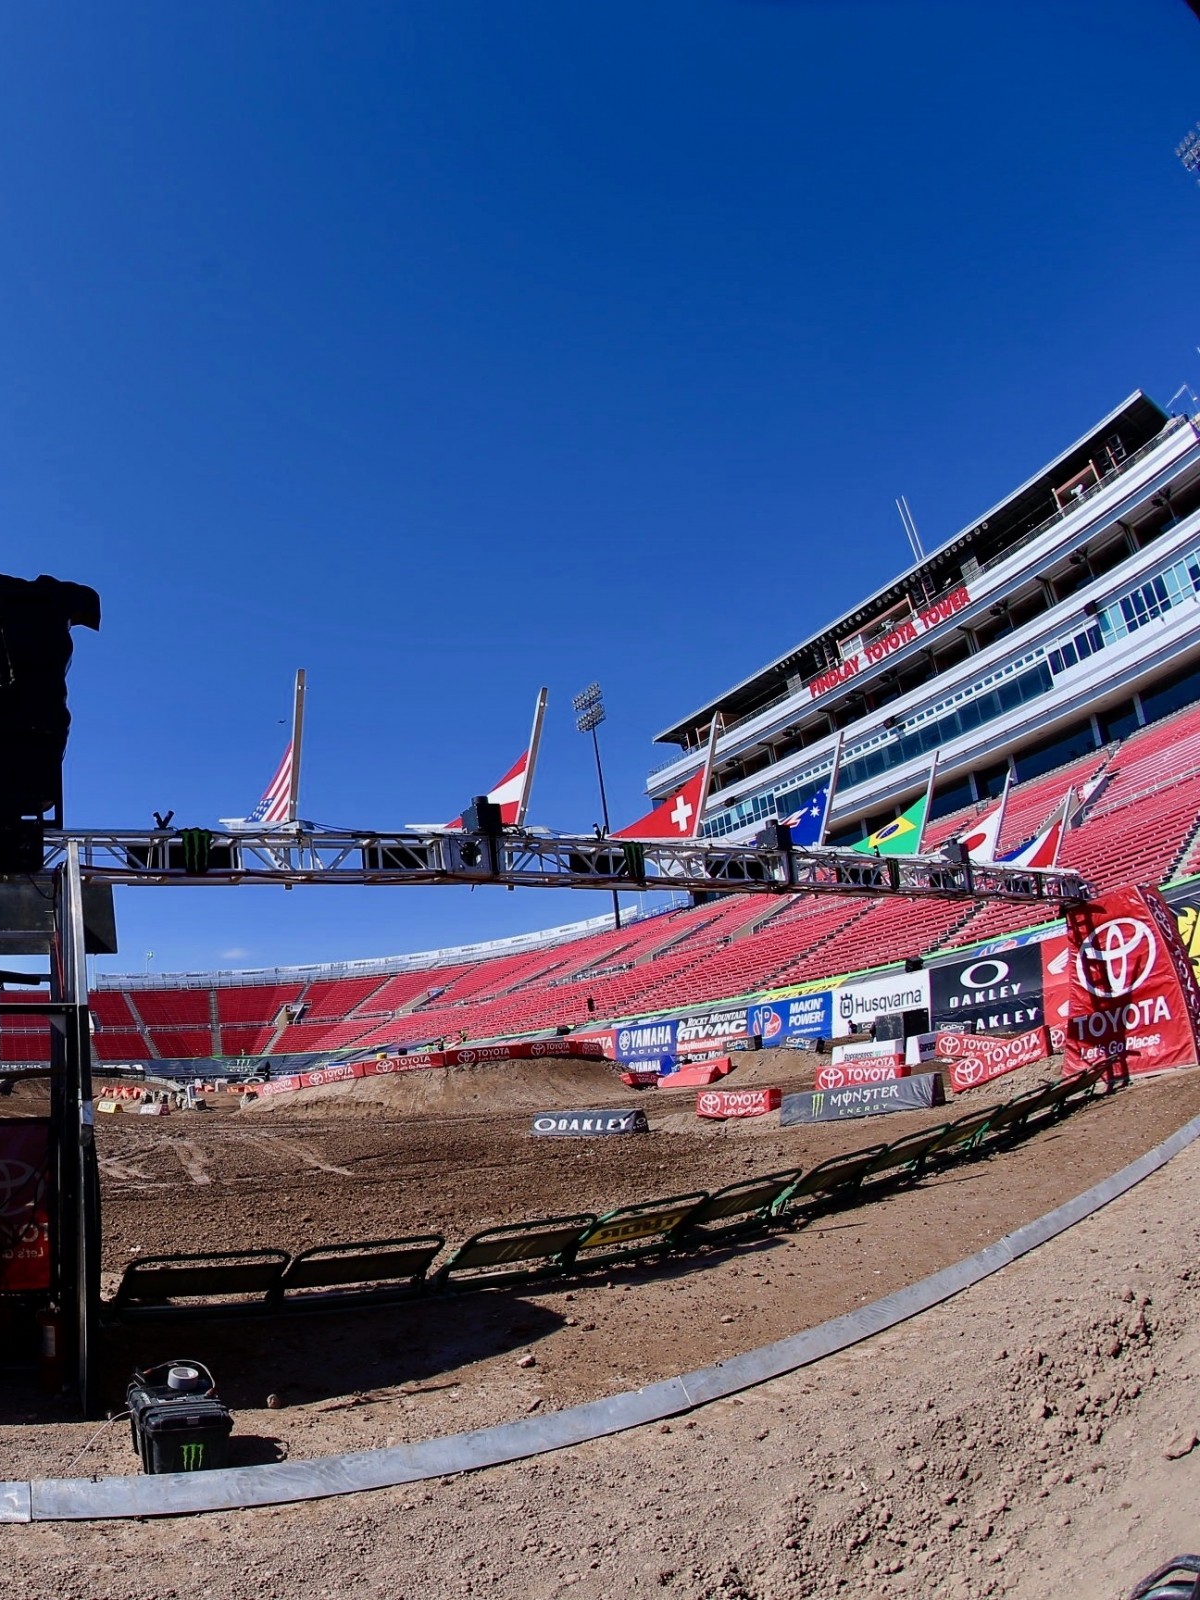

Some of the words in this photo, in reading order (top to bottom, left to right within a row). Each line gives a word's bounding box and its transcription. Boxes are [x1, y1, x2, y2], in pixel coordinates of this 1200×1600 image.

[809, 656, 860, 698] FINDLAY
[864, 621, 918, 664] TOYOTA
[918, 586, 970, 629] TOWER
[855, 989, 922, 1014] Husqvarna
[949, 983, 1021, 1008] OAKLEY
[687, 1016, 708, 1027] ROCKY
[709, 1010, 747, 1023] MOUNTAIN
[789, 1010, 826, 1027] POWER!
[963, 1007, 1039, 1030] AKLEY
[1073, 996, 1171, 1040] TOYOTA
[631, 1025, 671, 1048] YAMAHA
[726, 1040, 748, 1048] GoPro
[786, 1037, 810, 1045] GoPro
[477, 1048, 510, 1056] TOYOTA
[623, 1046, 669, 1056] RACING
[962, 1039, 1001, 1050] TOYOT
[984, 1033, 1040, 1065] TOYOTA
[1081, 1044, 1105, 1060] Let's
[1108, 1041, 1123, 1055] Go
[1125, 1033, 1161, 1050] Places
[396, 1056, 431, 1066] TOYOTA
[635, 1060, 661, 1073] YAMAHA
[988, 1064, 1005, 1075] Let's
[1007, 1058, 1017, 1067] Go
[1019, 1049, 1041, 1062] Places
[323, 1066, 354, 1078] TOYOTA
[847, 1069, 895, 1080] TOYOTA
[723, 1094, 764, 1106] TOYOTA
[829, 1085, 899, 1107] MONSTER
[839, 1103, 888, 1115] ENERGY
[557, 1118, 630, 1131] OAKLEY
